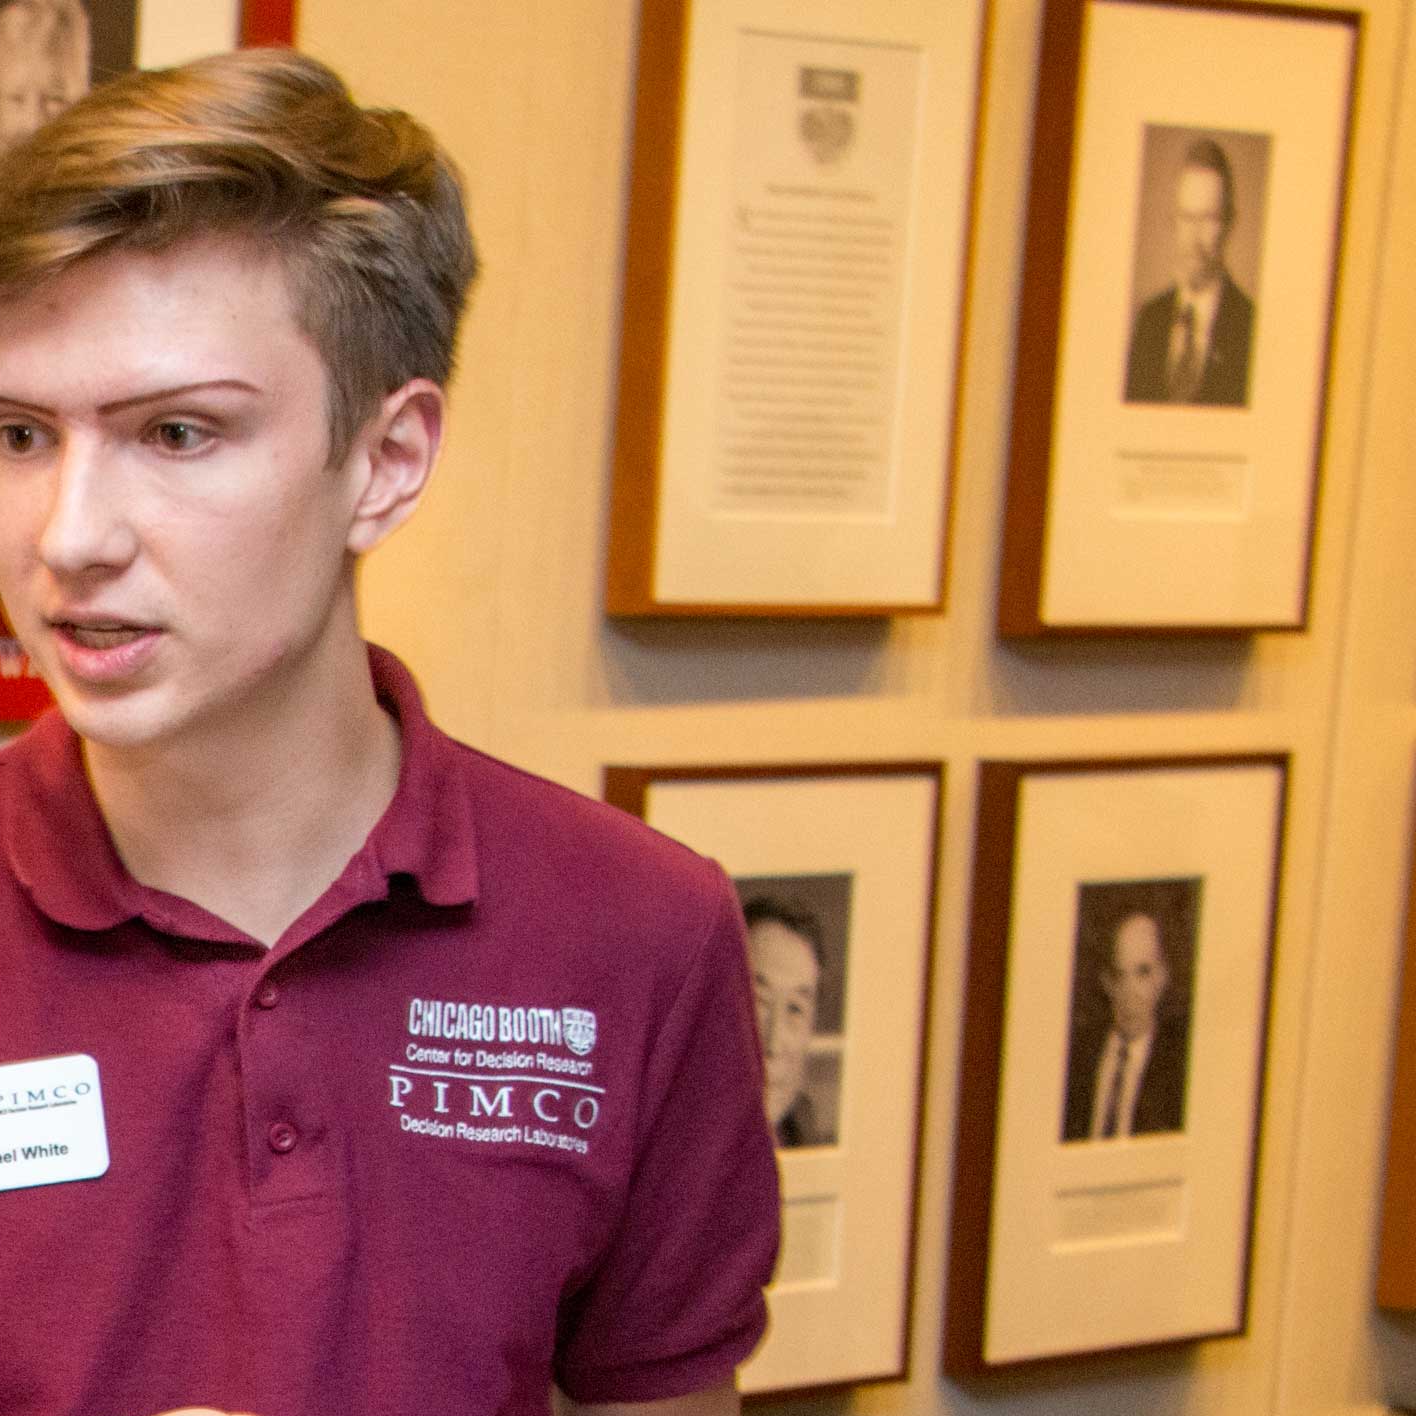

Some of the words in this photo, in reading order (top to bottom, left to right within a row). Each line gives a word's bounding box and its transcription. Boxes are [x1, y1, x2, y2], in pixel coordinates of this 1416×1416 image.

[407, 996, 496, 1043] CHICAGO
[499, 1006, 563, 1047] BOOTH
[406, 1042, 451, 1067] Center
[453, 1047, 474, 1068] for
[475, 1049, 536, 1072] Decision
[536, 1053, 593, 1076] Research
[388, 1074, 601, 1130] PIMCO
[399, 1114, 455, 1140] Decision
[455, 1121, 522, 1145] Research
[20, 1142, 70, 1162] White
